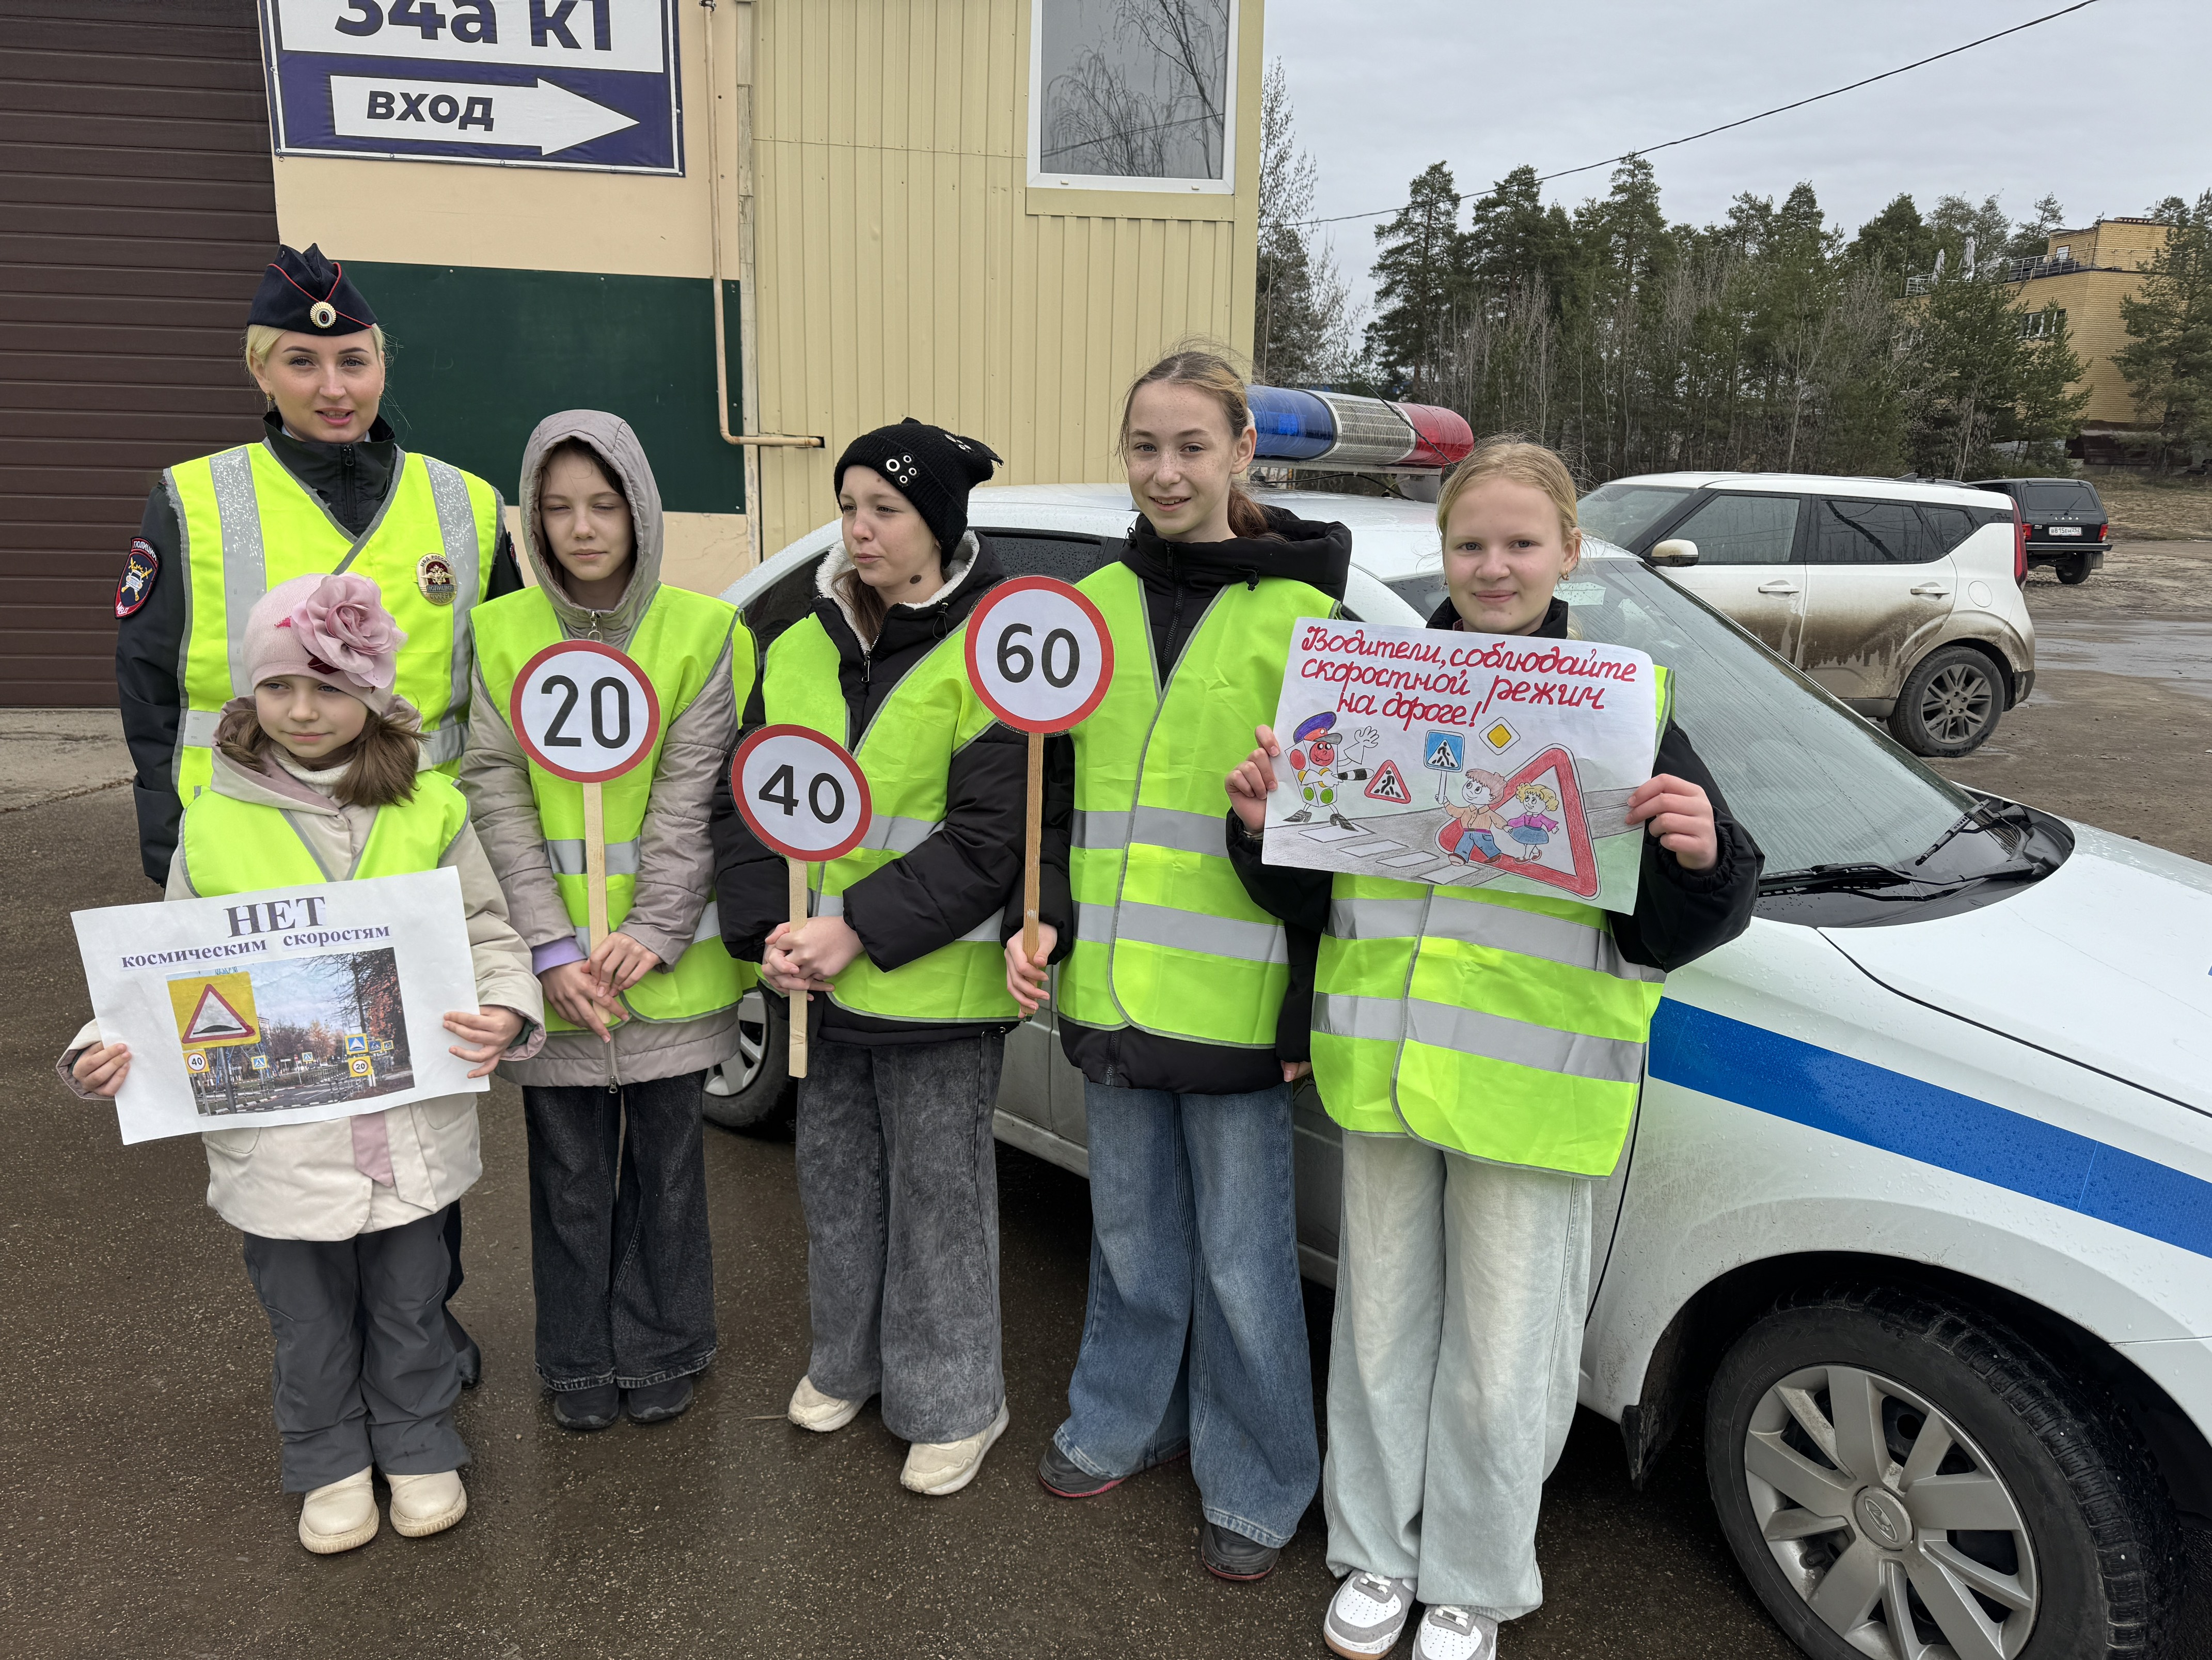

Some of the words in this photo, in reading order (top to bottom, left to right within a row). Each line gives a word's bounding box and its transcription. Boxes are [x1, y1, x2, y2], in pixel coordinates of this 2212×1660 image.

[133, 541, 157, 561] ПОЛИЦИЯ
[116, 601, 129, 615] МВД
[996, 623, 1080, 688] 60
[1301, 625, 1446, 670] Водители,
[1449, 641, 1637, 682] соблюдайте
[1301, 659, 1471, 696] скоростной
[541, 675, 631, 749] 20
[1336, 692, 1378, 716] на
[1382, 691, 1482, 731] дороге!
[758, 764, 845, 824] 40
[223, 896, 325, 938] НЕТ
[121, 939, 268, 968] космическим
[282, 925, 390, 947] скоростям
[192, 1057, 202, 1066] 40
